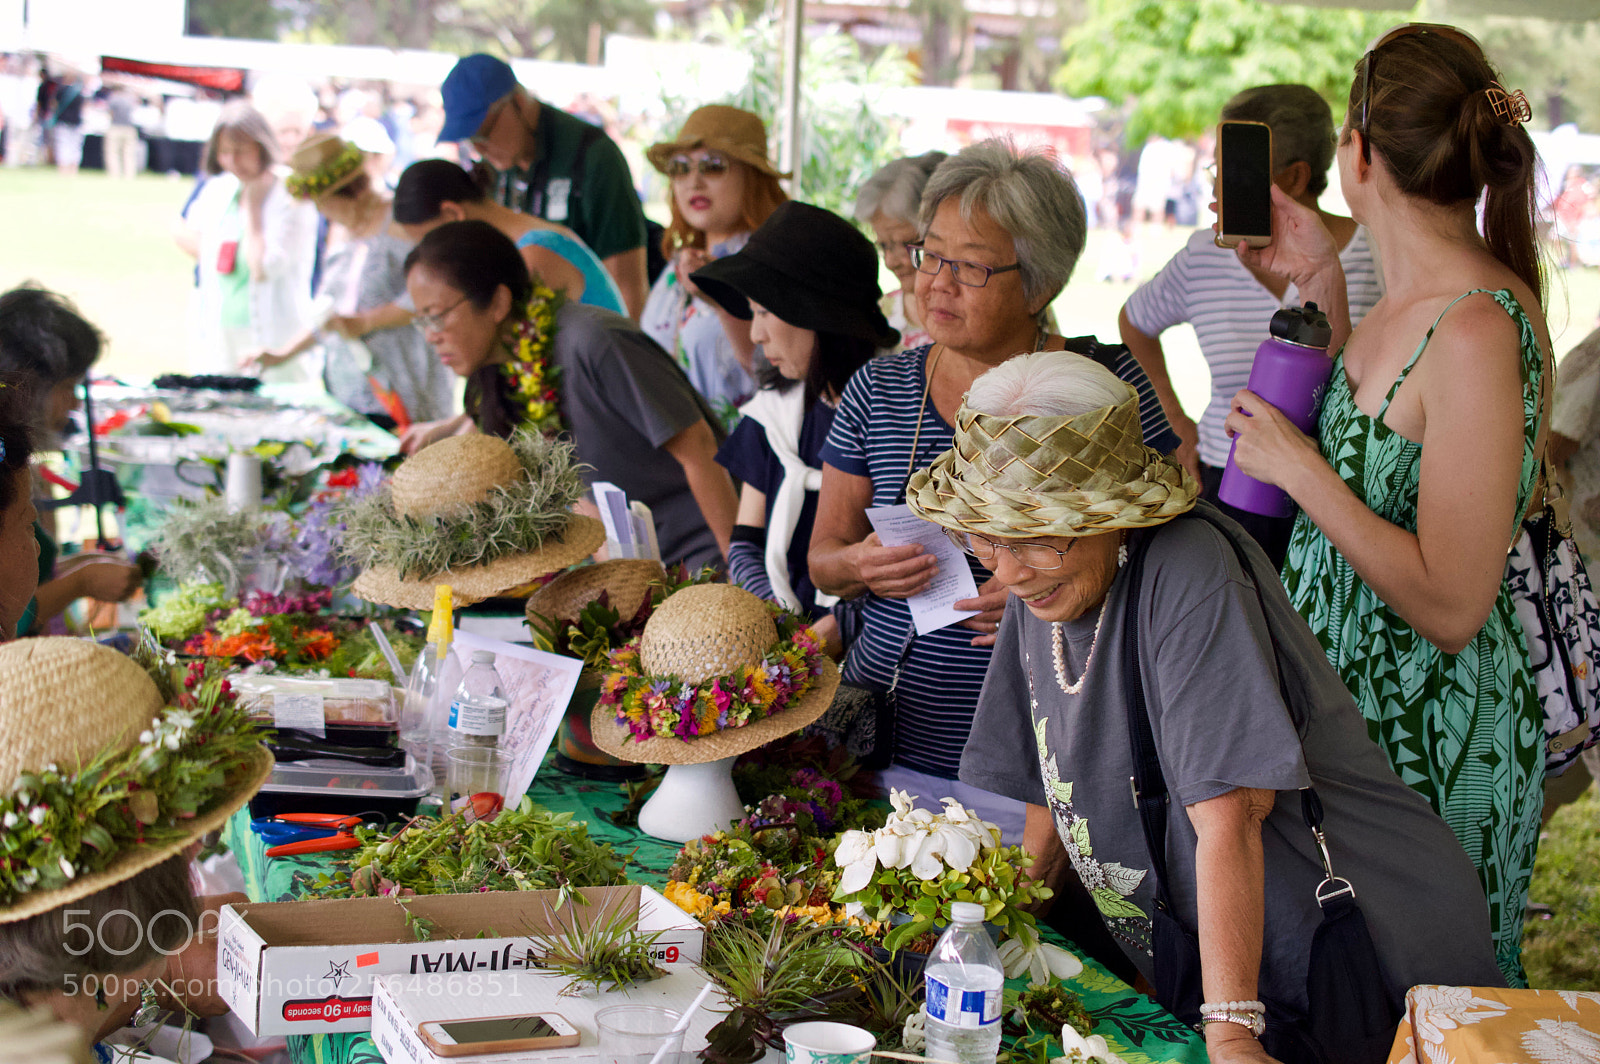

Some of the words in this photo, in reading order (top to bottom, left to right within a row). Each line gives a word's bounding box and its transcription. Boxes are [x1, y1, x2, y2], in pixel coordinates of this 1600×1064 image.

[409, 943, 550, 974] N-JI-MAI
[665, 945, 680, 963] 6
[287, 1007, 322, 1018] seconds
[323, 1004, 342, 1017] 90
[343, 1005, 351, 1014] in
[352, 1003, 372, 1014] eady
